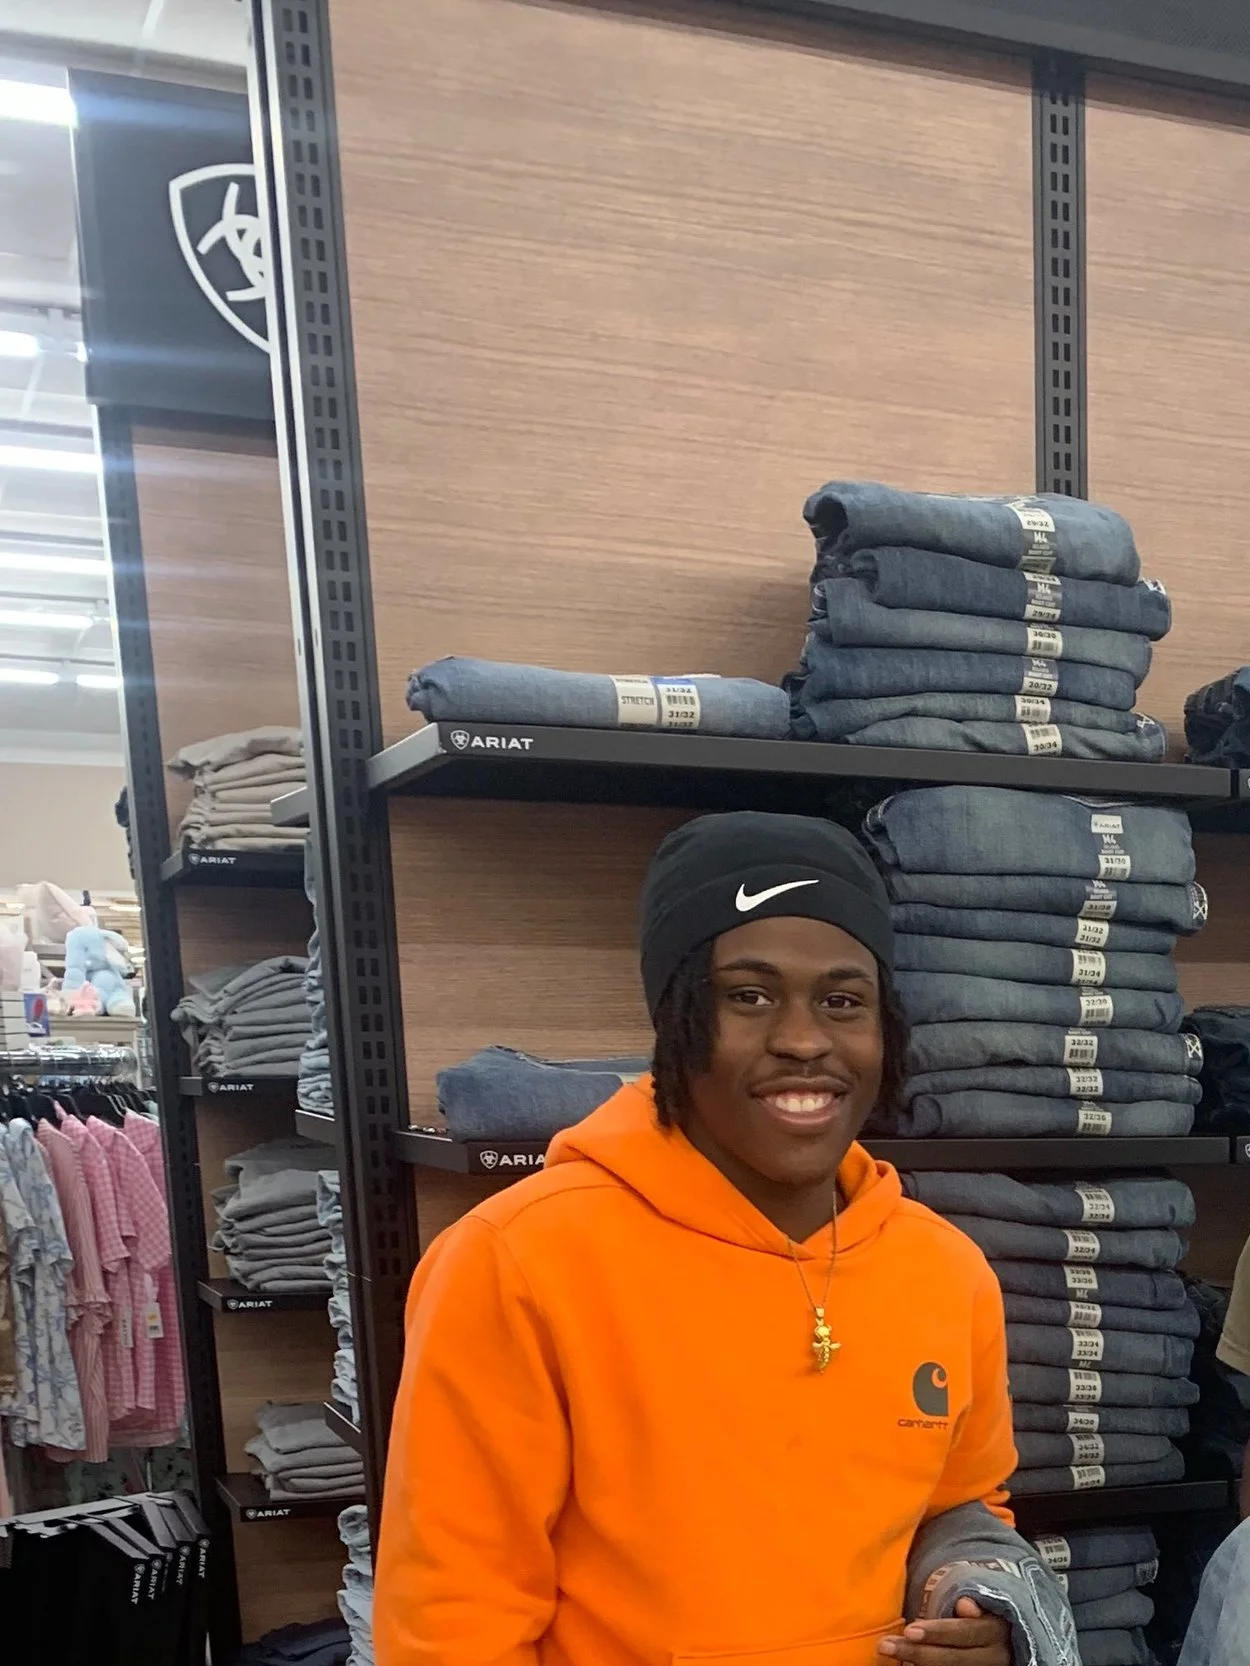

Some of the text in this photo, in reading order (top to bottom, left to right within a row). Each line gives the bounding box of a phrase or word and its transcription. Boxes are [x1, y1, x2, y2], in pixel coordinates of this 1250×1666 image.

[621, 695, 655, 706] STRETCH
[668, 710, 695, 719] 31/32
[471, 735, 534, 750] ARIAT
[200, 856, 237, 864] ARIAT
[1082, 925, 1104, 934] 31/32
[1080, 934, 1102, 943] 31/32
[1078, 969, 1101, 977] 31/34
[1075, 1075, 1098, 1083] 32/32
[1075, 1085, 1099, 1093] 32/32
[499, 1153, 546, 1166] ARIA
[1074, 1246, 1096, 1254] 32/34
[239, 1300, 273, 1309] ARIAT
[256, 1508, 291, 1518] ARIAT
[198, 1548, 207, 1578] ARIAT
[148, 1568, 158, 1600] ARIAT
[131, 1573, 141, 1605] ARIAT
